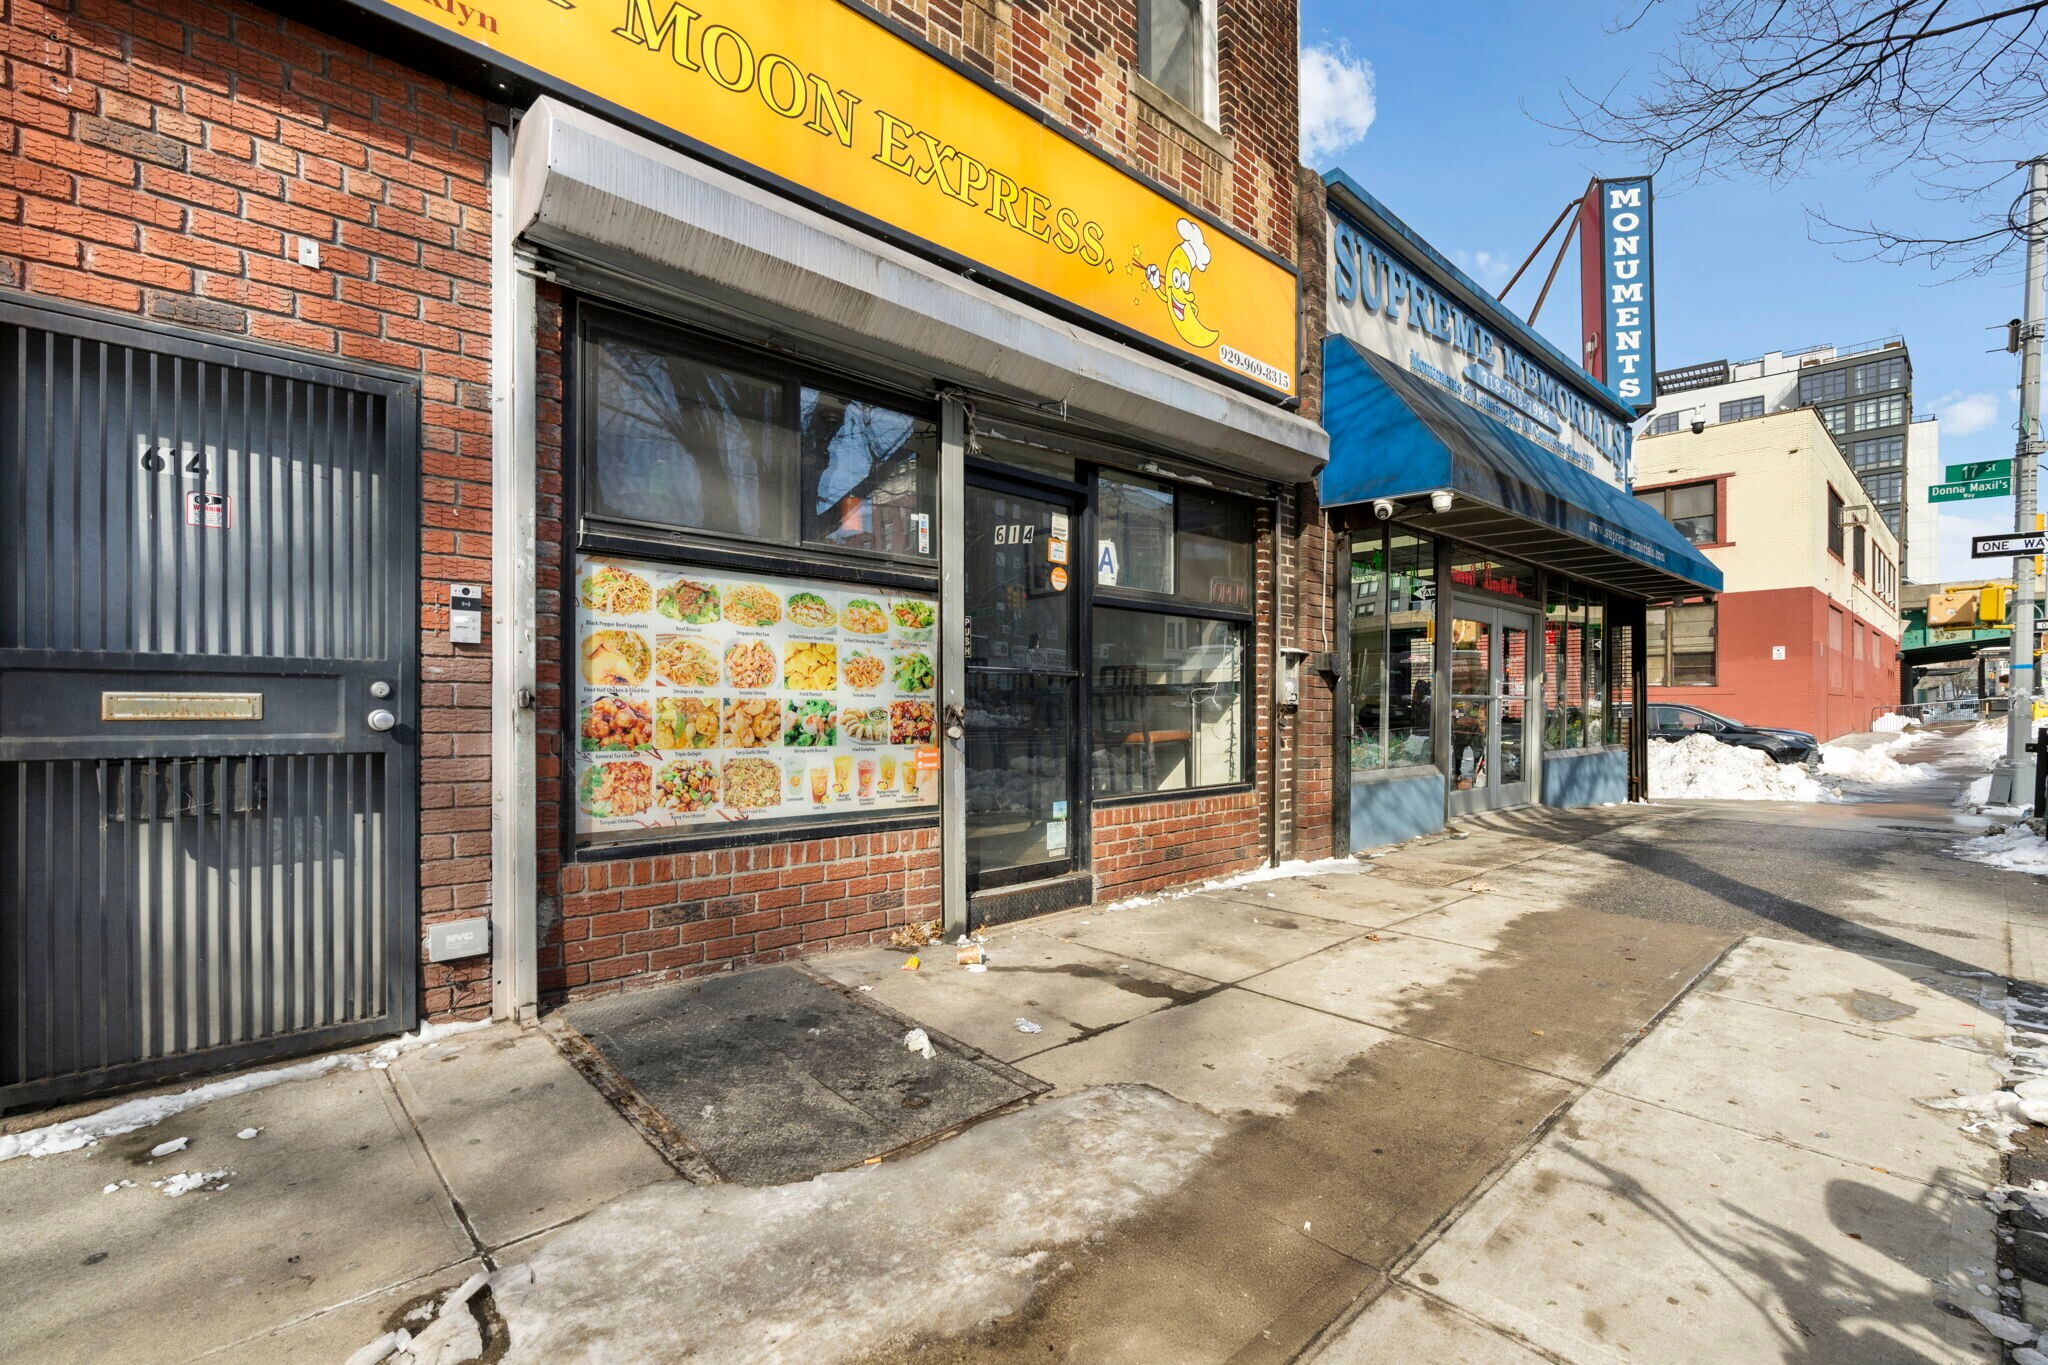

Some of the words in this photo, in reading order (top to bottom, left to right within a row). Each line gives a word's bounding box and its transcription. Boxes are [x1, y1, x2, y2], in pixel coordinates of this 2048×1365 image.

[610, 0, 862, 148] MOON
[873, 109, 1115, 274] EXPRESS.
[1610, 187, 1643, 398] MONUMENTS
[1334, 222, 1496, 367] SUPREME
[1503, 343, 1625, 470] MEMORIALS
[1220, 346, 1289, 388] 929-969-8315
[1481, 370, 1550, 423] 718-788-7986
[1962, 464, 1979, 479] 17
[1985, 463, 1997, 472] St
[1932, 486, 1966, 496] Donna
[1970, 480, 2009, 492] Maxil's
[193, 503, 226, 513] WRNIN
[996, 526, 1033, 543] 614
[1982, 541, 2010, 552] ONE
[2024, 537, 2048, 549] WA
[1097, 546, 1115, 574] A
[446, 931, 474, 943] NYC
